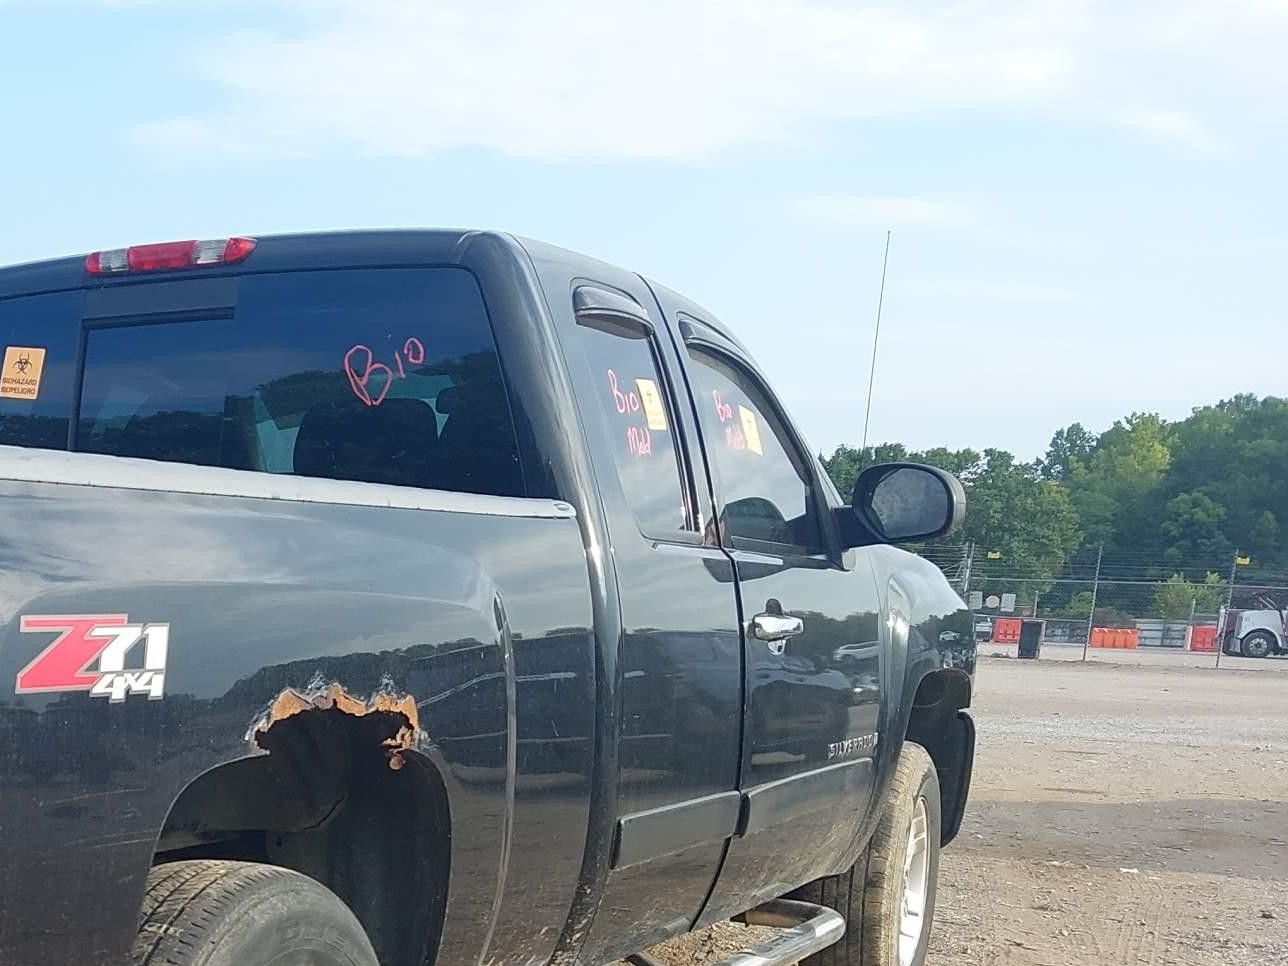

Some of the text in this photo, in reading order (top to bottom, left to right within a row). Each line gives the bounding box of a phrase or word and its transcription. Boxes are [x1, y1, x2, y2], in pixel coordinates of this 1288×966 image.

[0, 386, 37, 395] BIOPELIGRO
[2, 377, 38, 386] BIOHAZARD
[15, 613, 170, 695] Z71
[826, 731, 879, 760] SILVERADO
